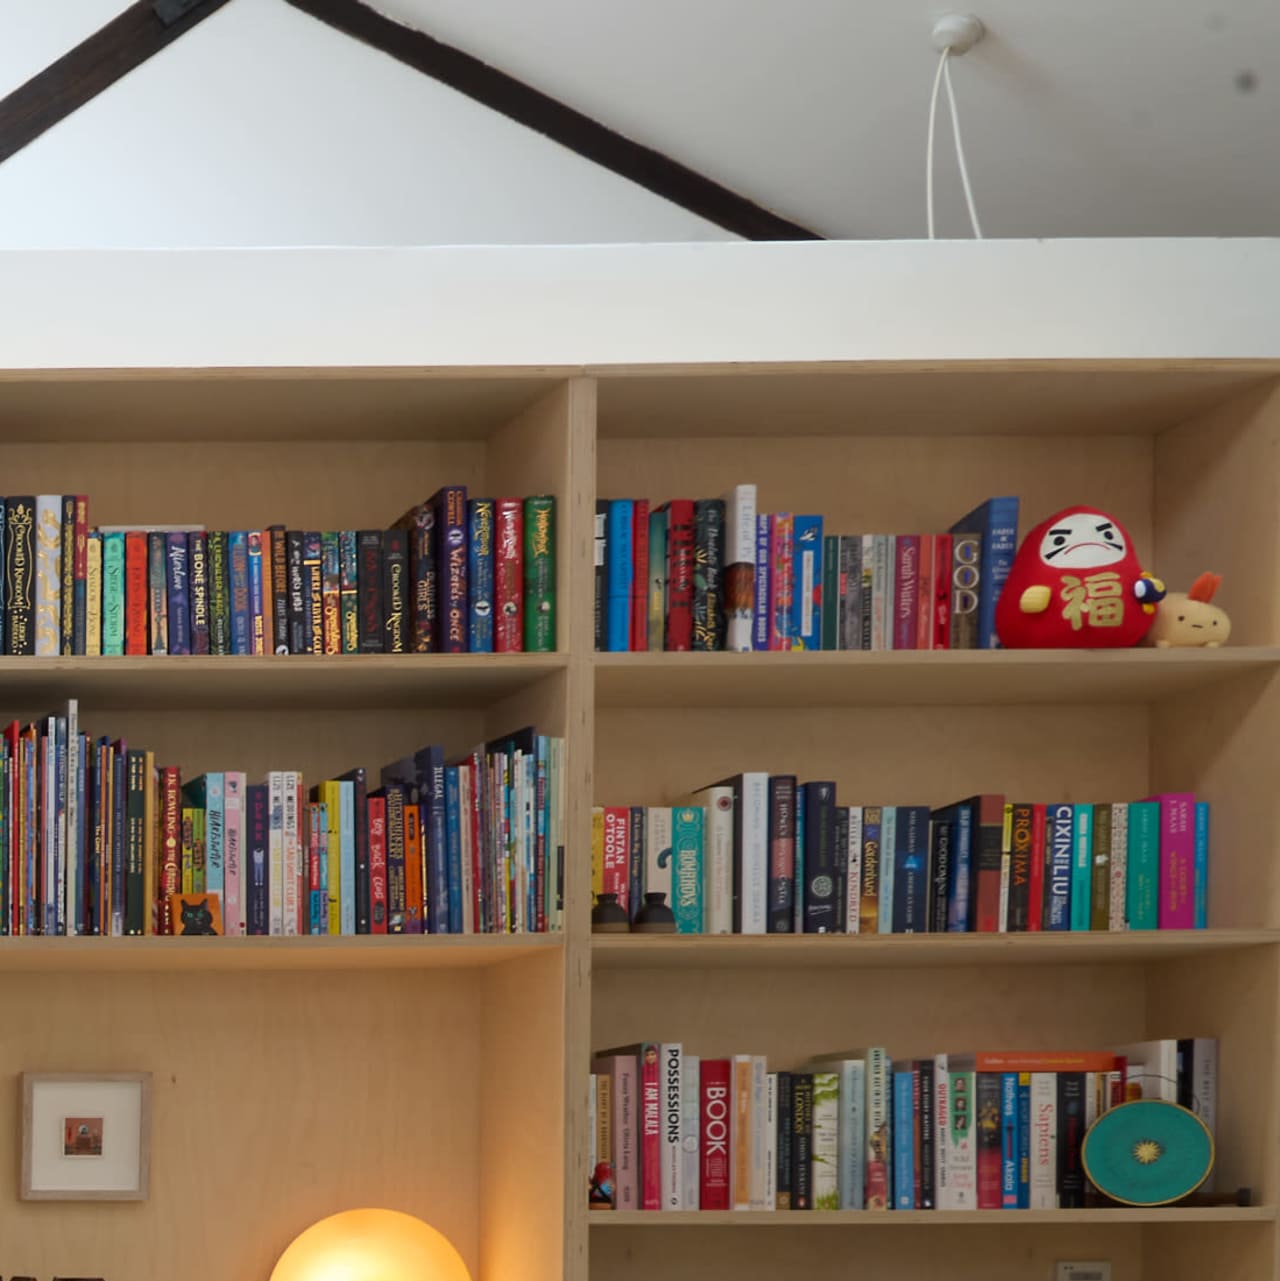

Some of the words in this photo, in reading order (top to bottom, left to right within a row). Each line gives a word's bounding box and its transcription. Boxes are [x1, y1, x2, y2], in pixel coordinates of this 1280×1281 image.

[194, 554, 204, 584] BONE
[902, 547, 914, 578] Sarah
[955, 540, 978, 614] GOD
[195, 587, 205, 625] SPINDLE
[901, 581, 914, 618] Waters
[1060, 572, 1124, 630] 福
[433, 767, 444, 799] ILLEGAL
[605, 814, 616, 869] O'TOOLE
[615, 818, 624, 864] FINTAN
[1014, 808, 1029, 885] PROXIMA
[1057, 806, 1072, 858] CIXIN
[849, 872, 857, 922] KINDRED
[1053, 866, 1070, 895] LIU
[646, 1089, 656, 1103] AM
[667, 1049, 679, 1143] POSSESSIONS
[795, 1092, 804, 1133] LONDON
[1005, 1077, 1014, 1116] Natives
[646, 1107, 656, 1135] MALALA
[706, 1087, 726, 1155] BOOK
[1038, 1104, 1053, 1165] Sapiens
[1005, 1161, 1014, 1190] Akala
